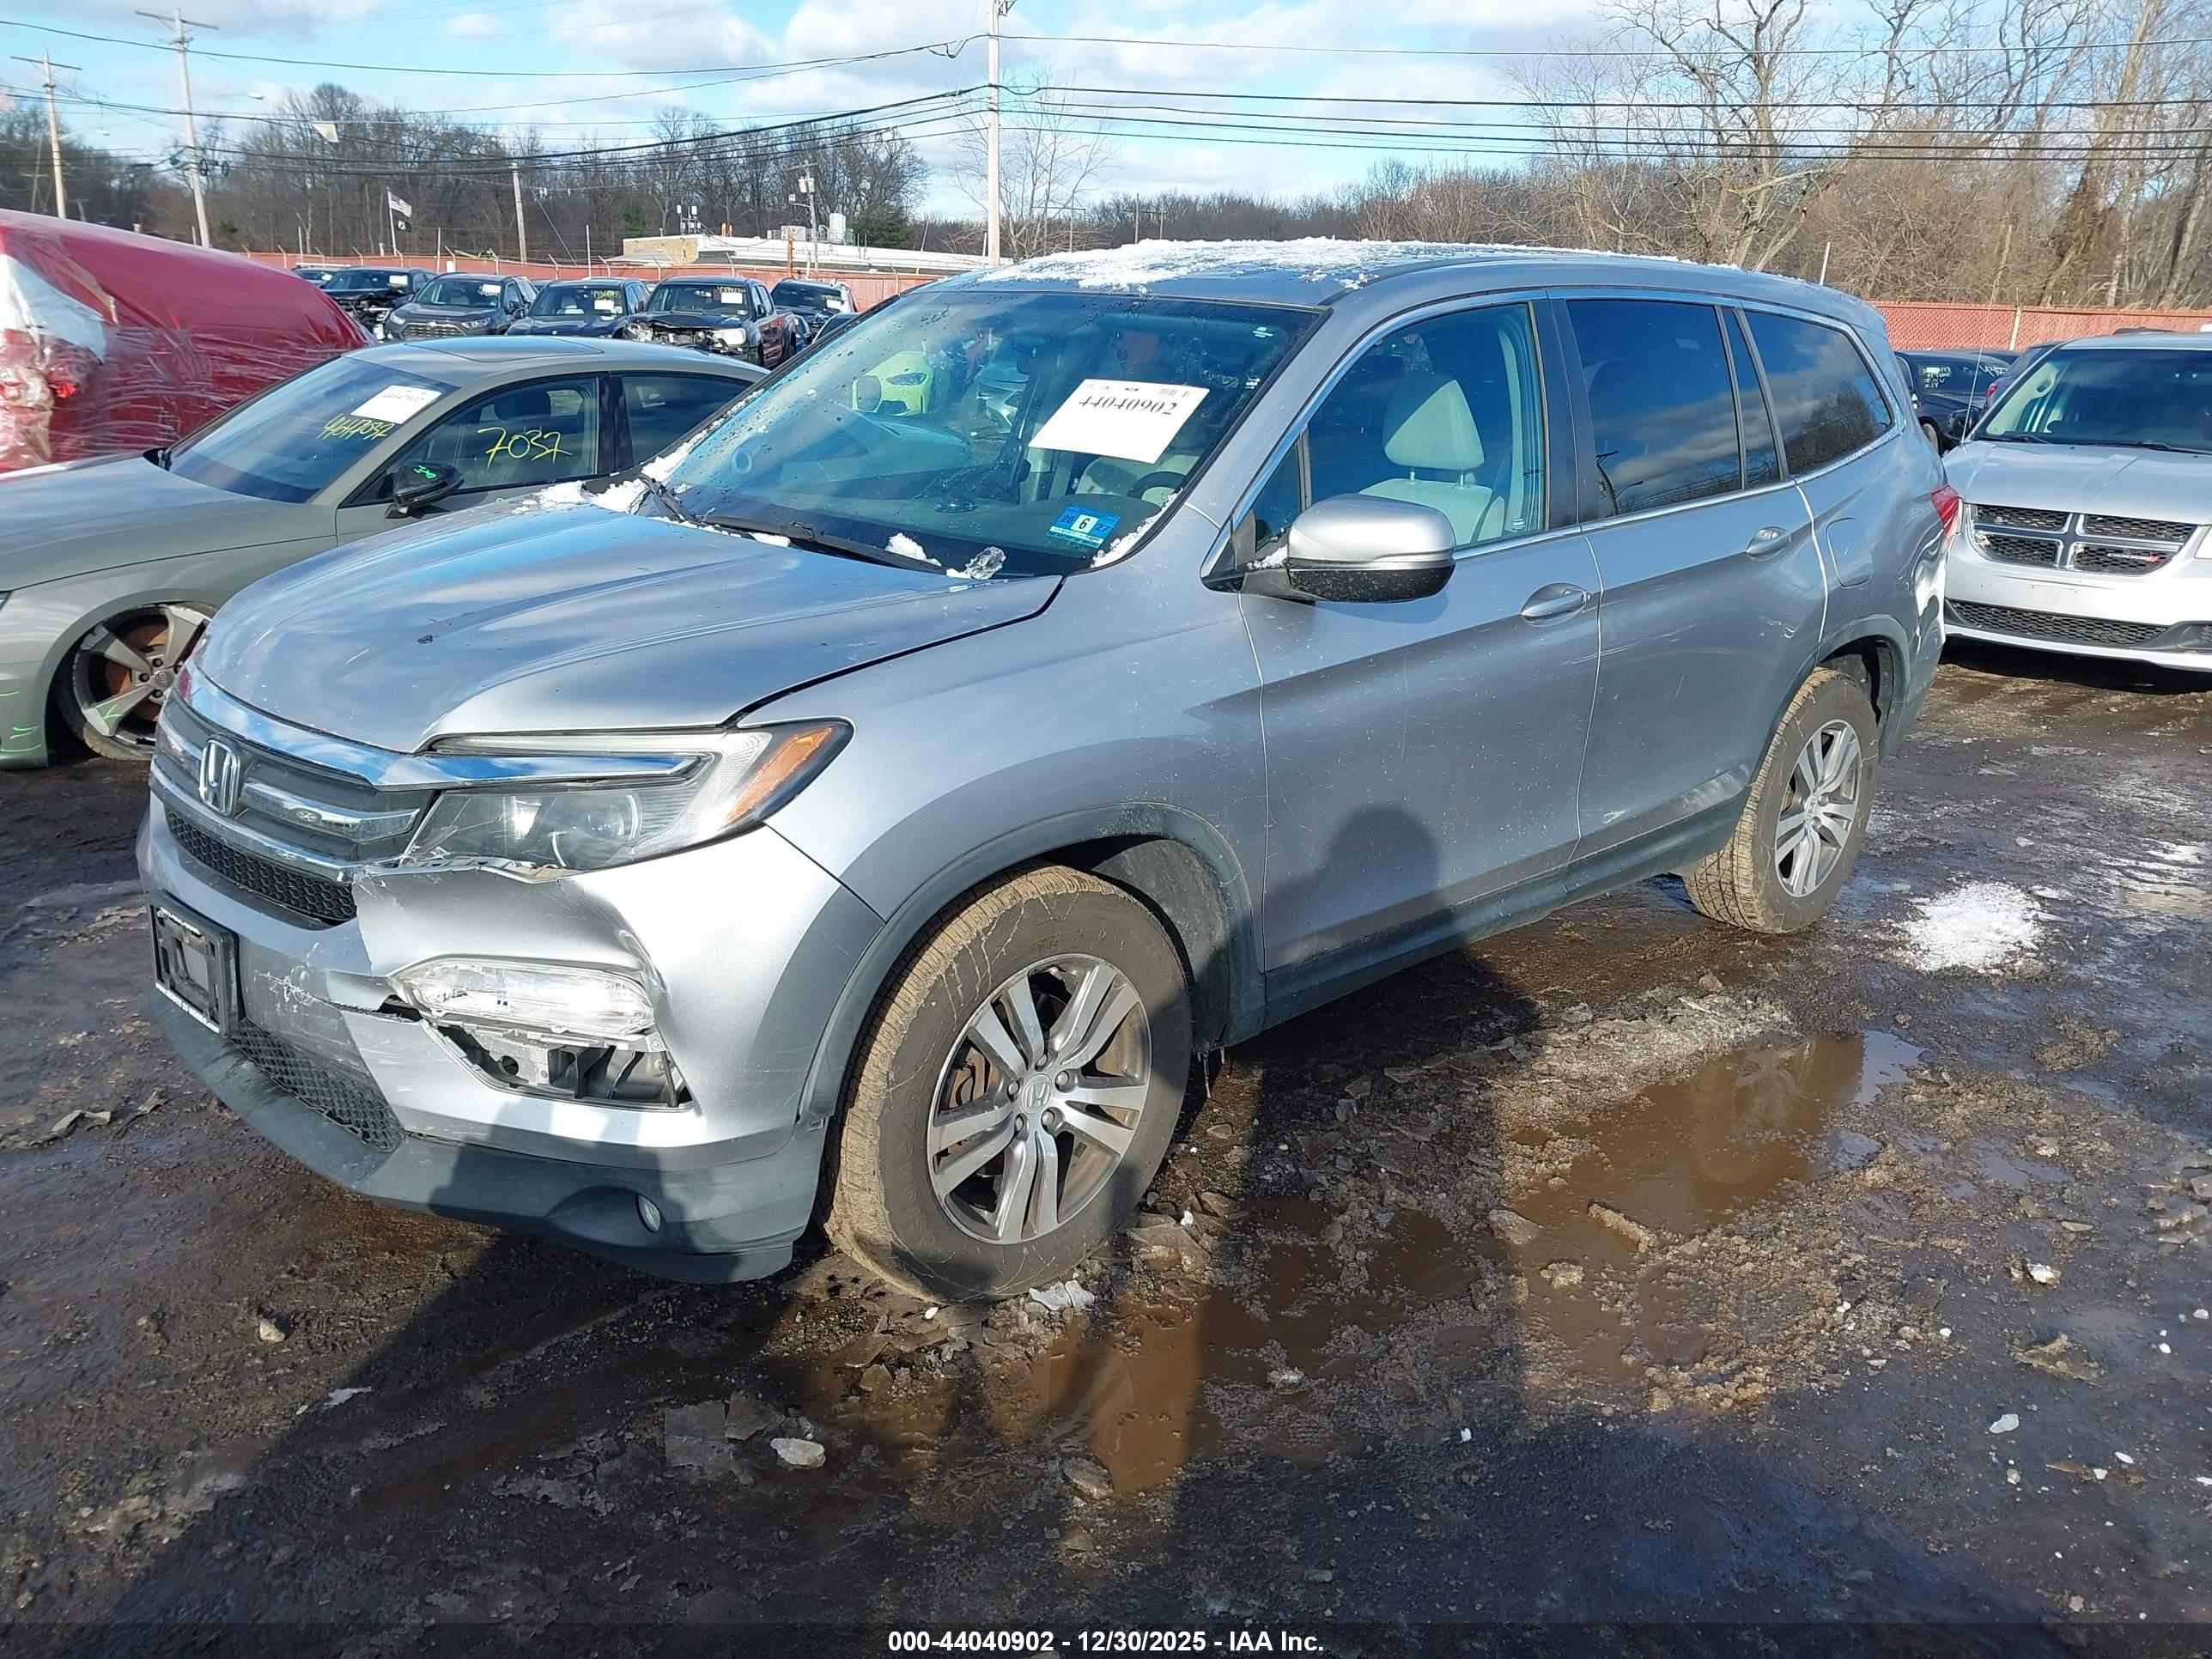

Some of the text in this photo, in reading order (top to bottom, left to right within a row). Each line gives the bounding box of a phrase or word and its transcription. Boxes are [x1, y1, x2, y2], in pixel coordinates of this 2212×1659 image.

[1079, 395, 1177, 415] 44040902
[477, 427, 573, 470] 7037
[1079, 517, 1091, 530] 6
